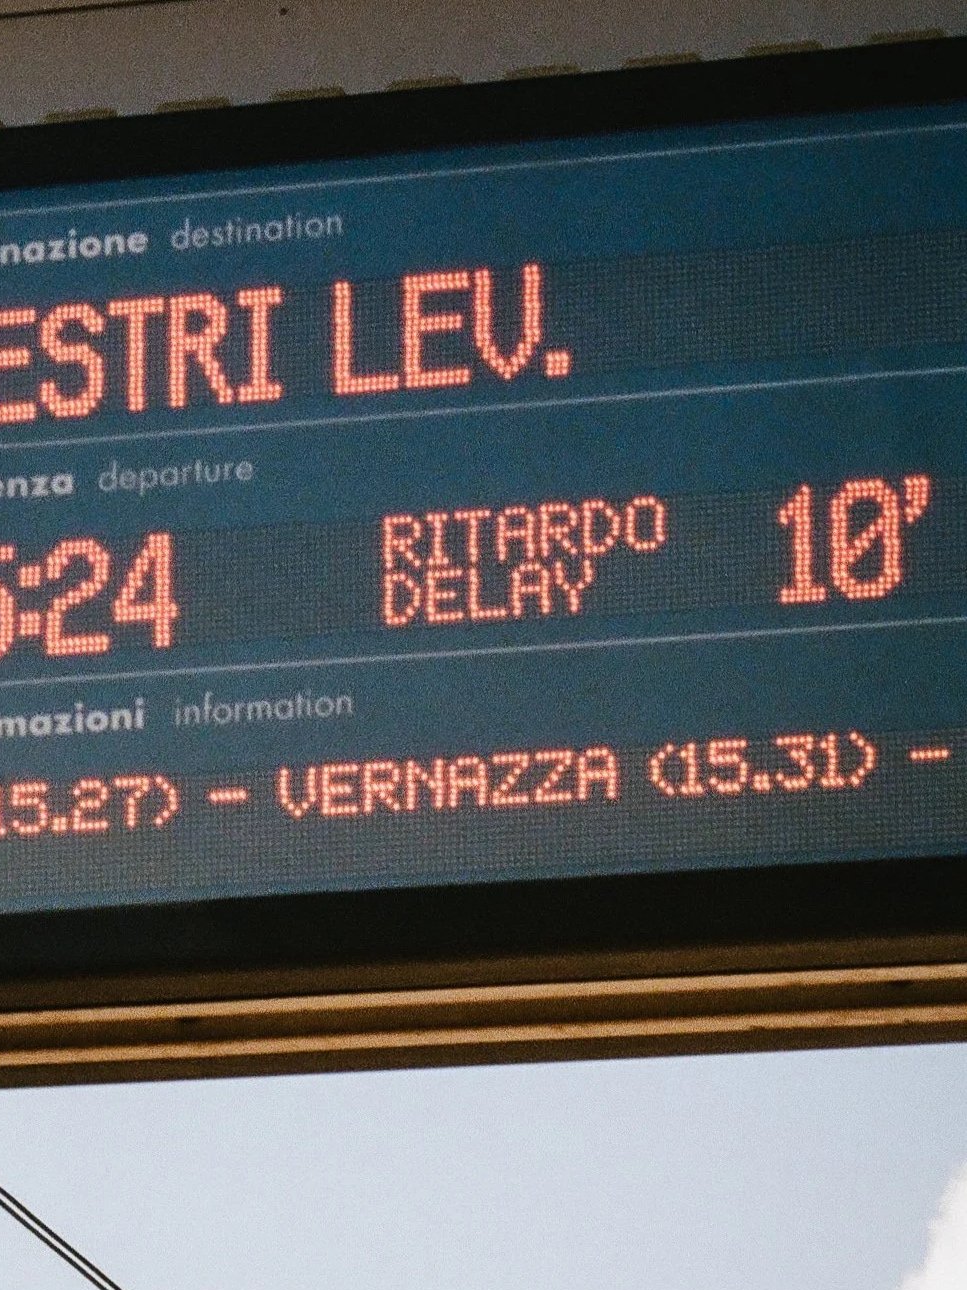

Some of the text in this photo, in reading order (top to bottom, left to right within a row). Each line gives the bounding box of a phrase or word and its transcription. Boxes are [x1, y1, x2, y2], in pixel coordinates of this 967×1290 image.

[170, 213, 345, 252] destination
[331, 262, 574, 398] LEV.
[97, 459, 256, 497] departure
[382, 495, 668, 568] RITARDO
[382, 558, 597, 627] DELAY
[174, 689, 356, 728] information
[276, 746, 621, 819] VERNAZZA
[647, 730, 880, 800] (15.31)
